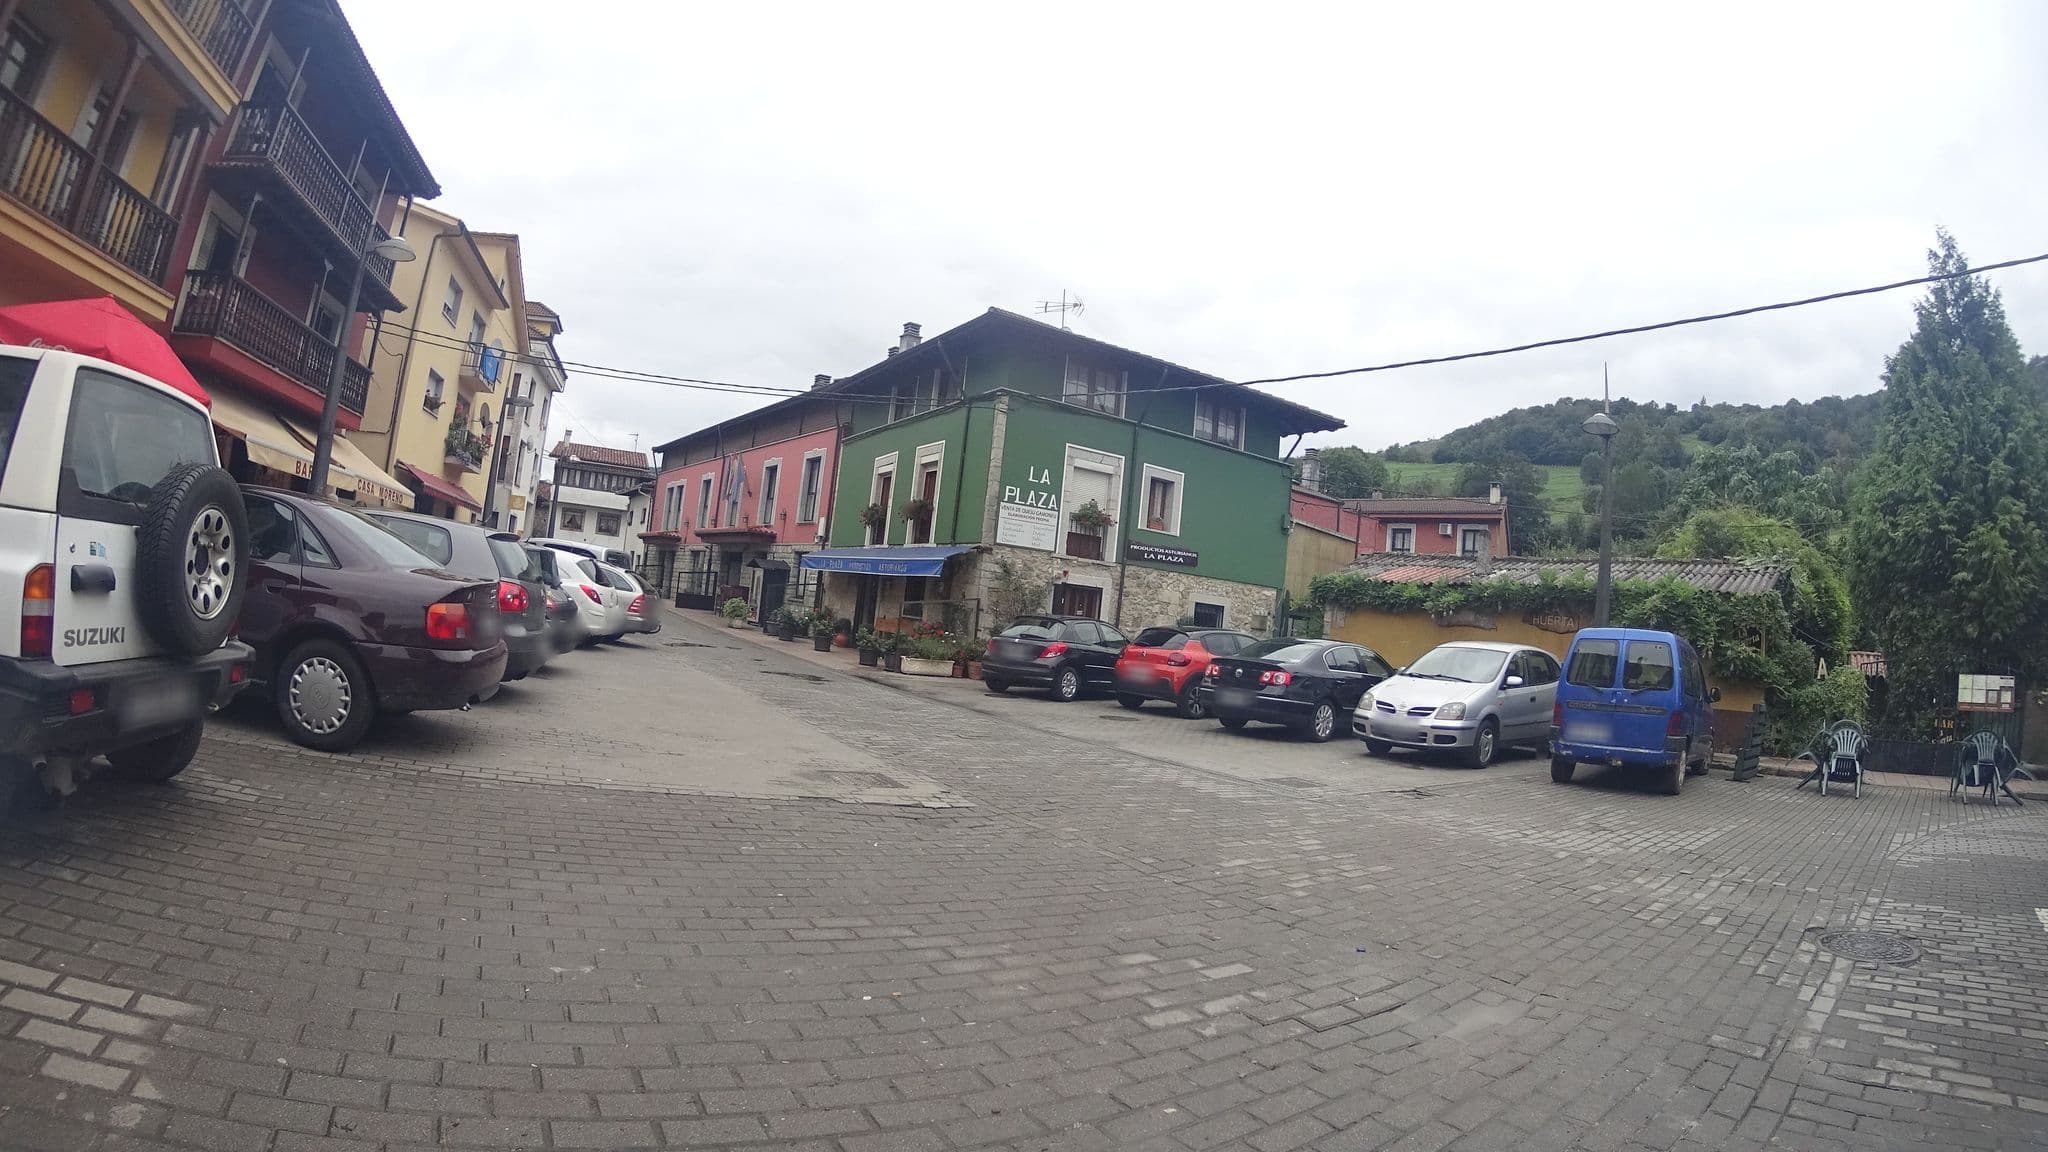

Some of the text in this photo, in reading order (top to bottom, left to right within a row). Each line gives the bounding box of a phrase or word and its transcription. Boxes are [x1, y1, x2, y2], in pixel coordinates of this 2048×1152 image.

[1028, 465, 1051, 485] LA
[357, 479, 403, 504] CASA MORENO
[1003, 485, 1058, 510] PLAZA
[1130, 544, 1164, 553] PRODUCTOS
[1157, 554, 1184, 563] PLAZA
[1532, 615, 1574, 628] HUERTA
[64, 626, 125, 648] SUZUKI
